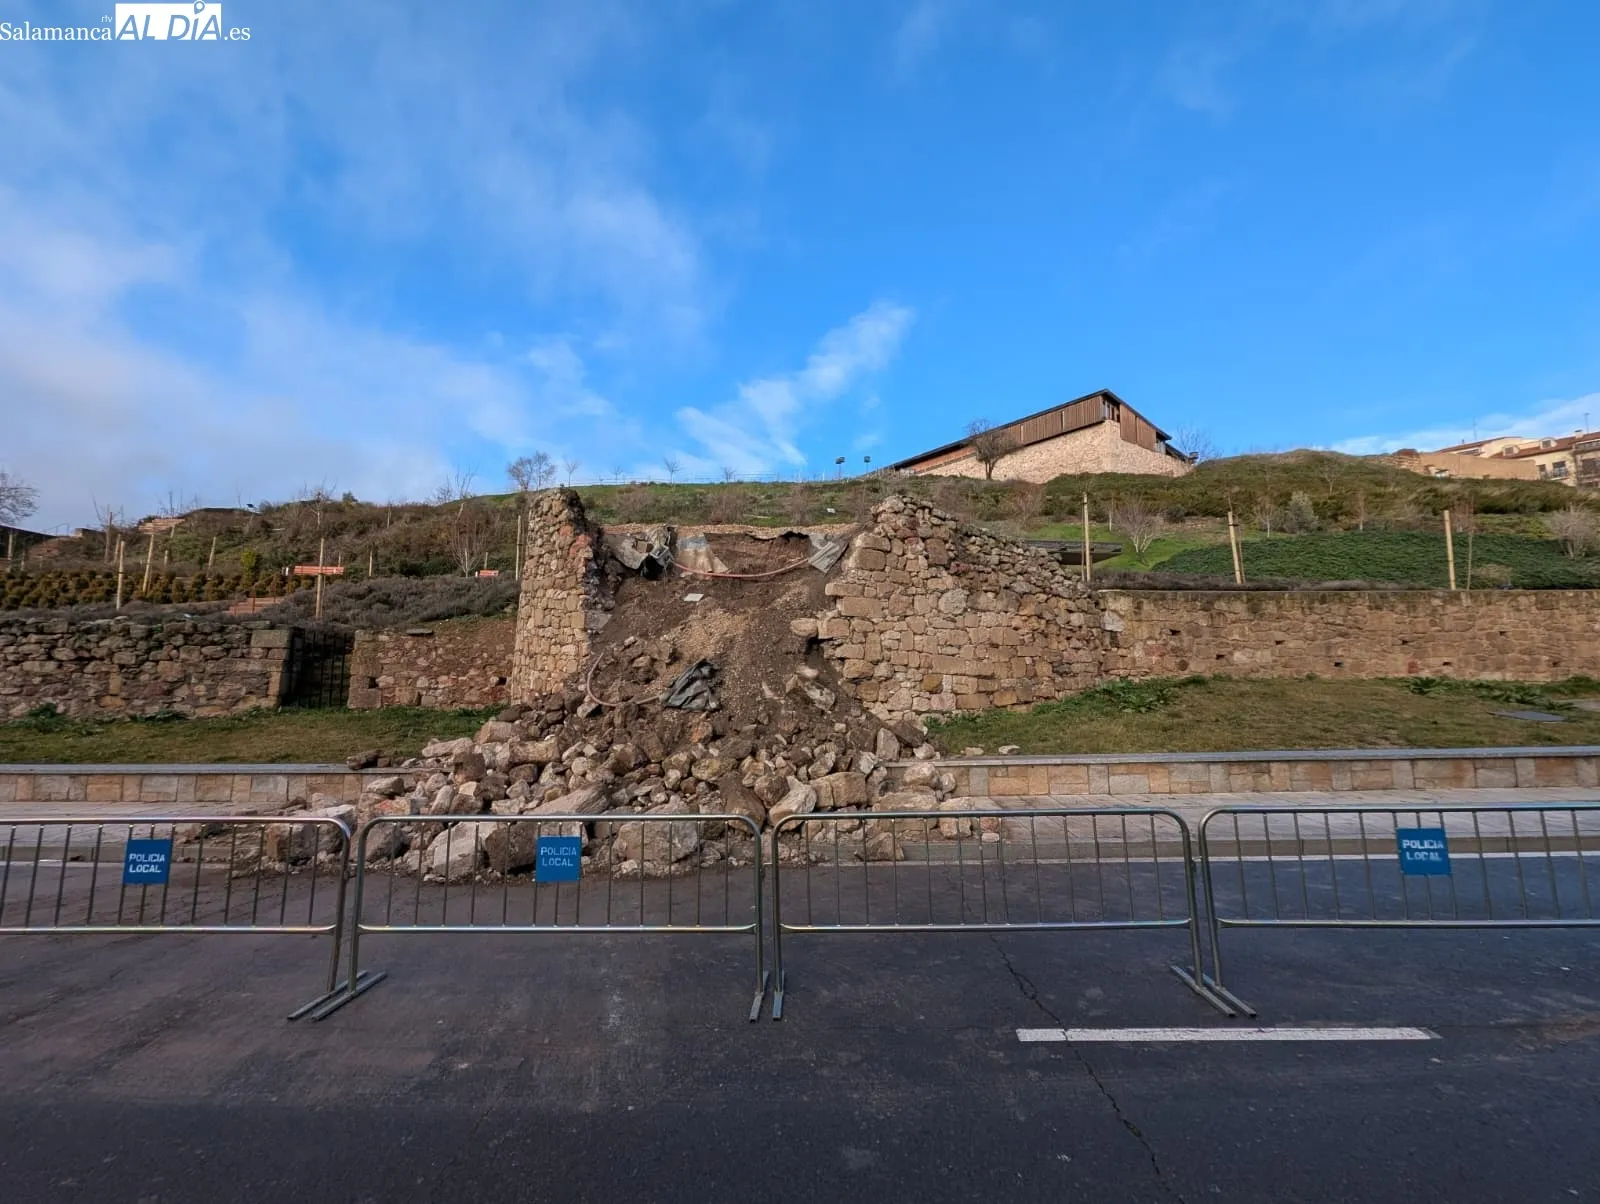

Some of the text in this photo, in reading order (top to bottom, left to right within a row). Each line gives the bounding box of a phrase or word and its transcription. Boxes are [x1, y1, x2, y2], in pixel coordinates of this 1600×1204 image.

[1402, 839, 1444, 850] POLICIA
[540, 846, 577, 856] POLICIA
[128, 853, 166, 863] POLICIA
[541, 857, 574, 867] LOCAL
[128, 864, 162, 873] LOCAL
